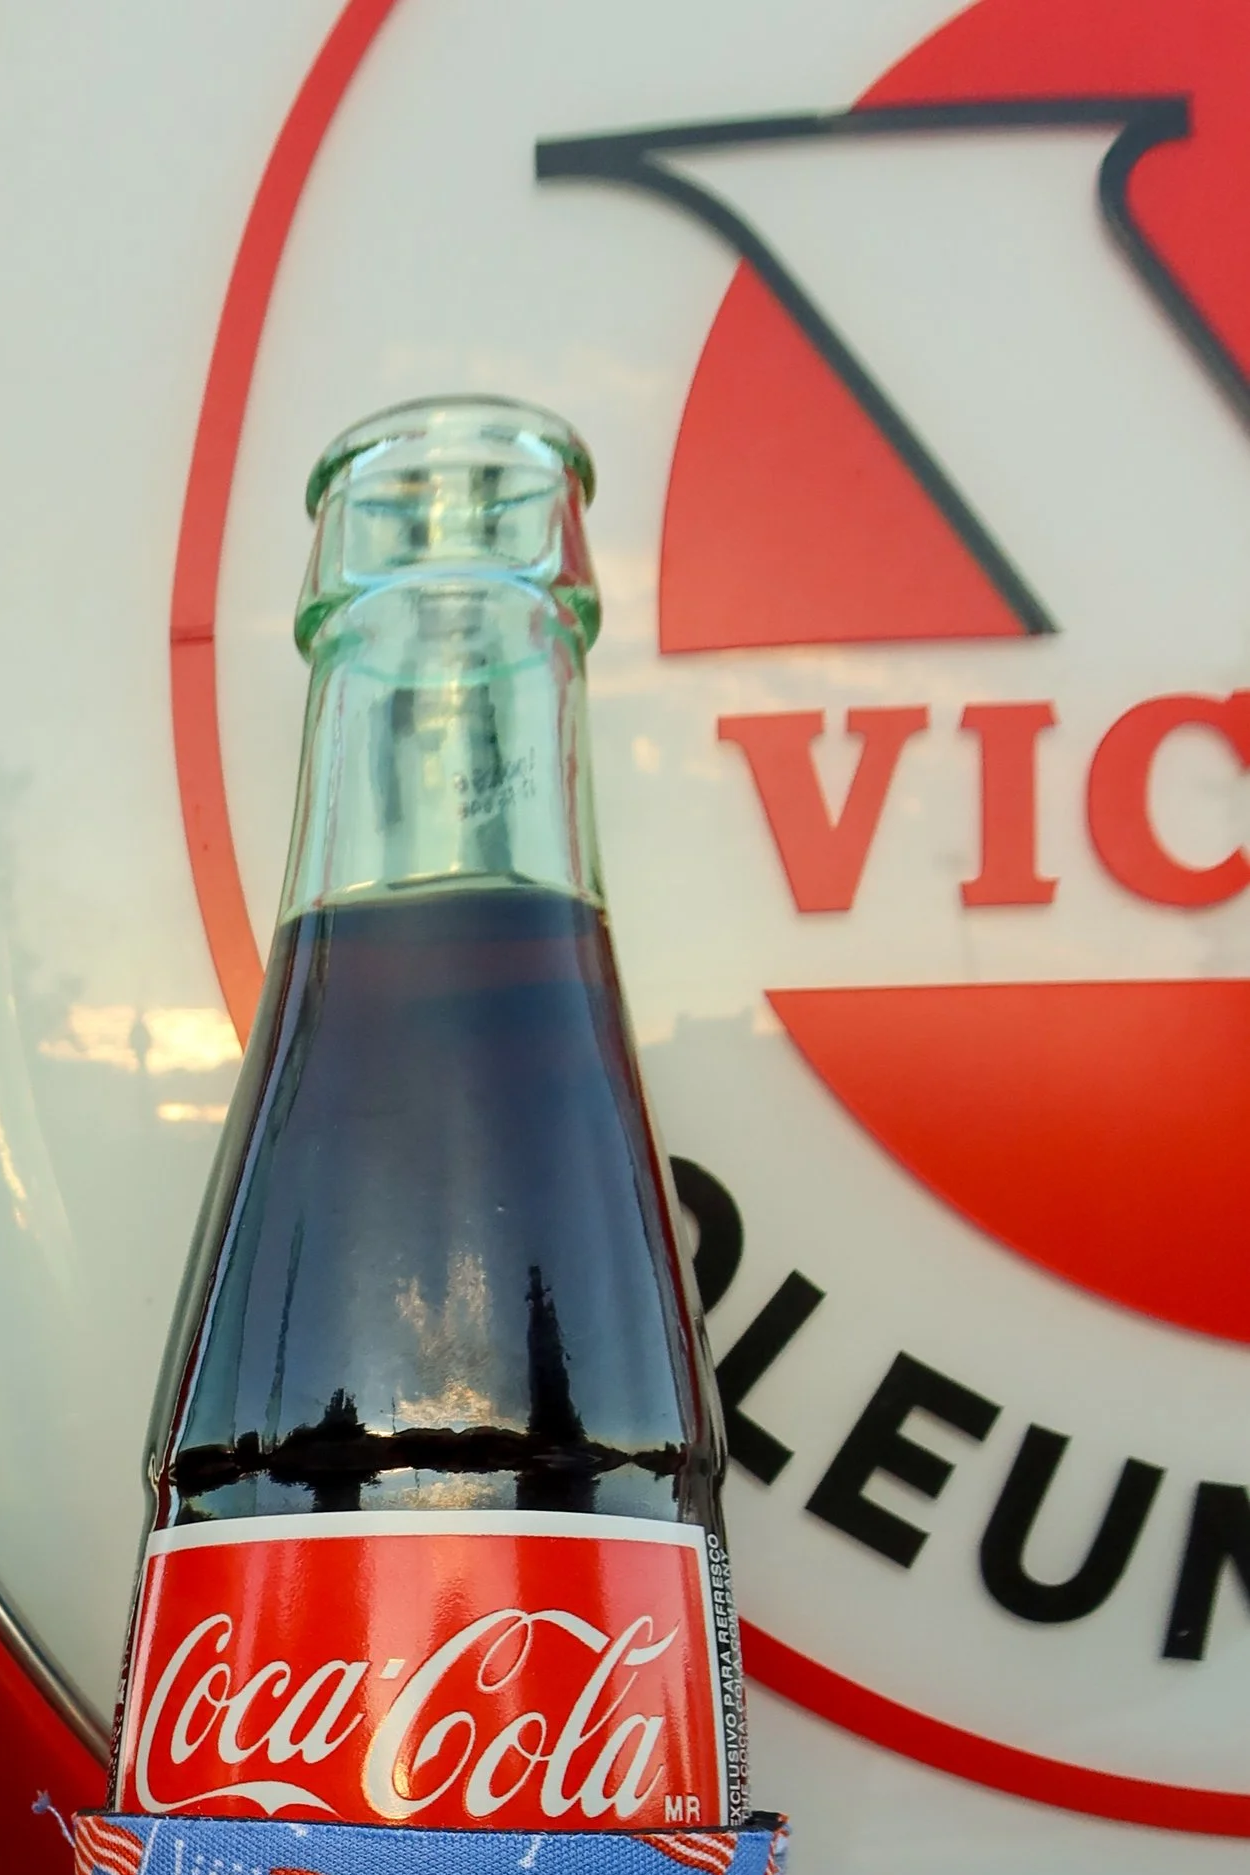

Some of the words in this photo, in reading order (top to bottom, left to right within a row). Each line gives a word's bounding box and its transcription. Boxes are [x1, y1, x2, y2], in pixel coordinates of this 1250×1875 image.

[717, 687, 1250, 913] VIC
[706, 1533, 730, 1644] REFRESCO
[135, 1608, 681, 1820] Coca-Cola
[719, 1650, 734, 1707] PARA
[664, 1794, 701, 1823] MR
[725, 1711, 742, 1826] EXCLUSIVO
